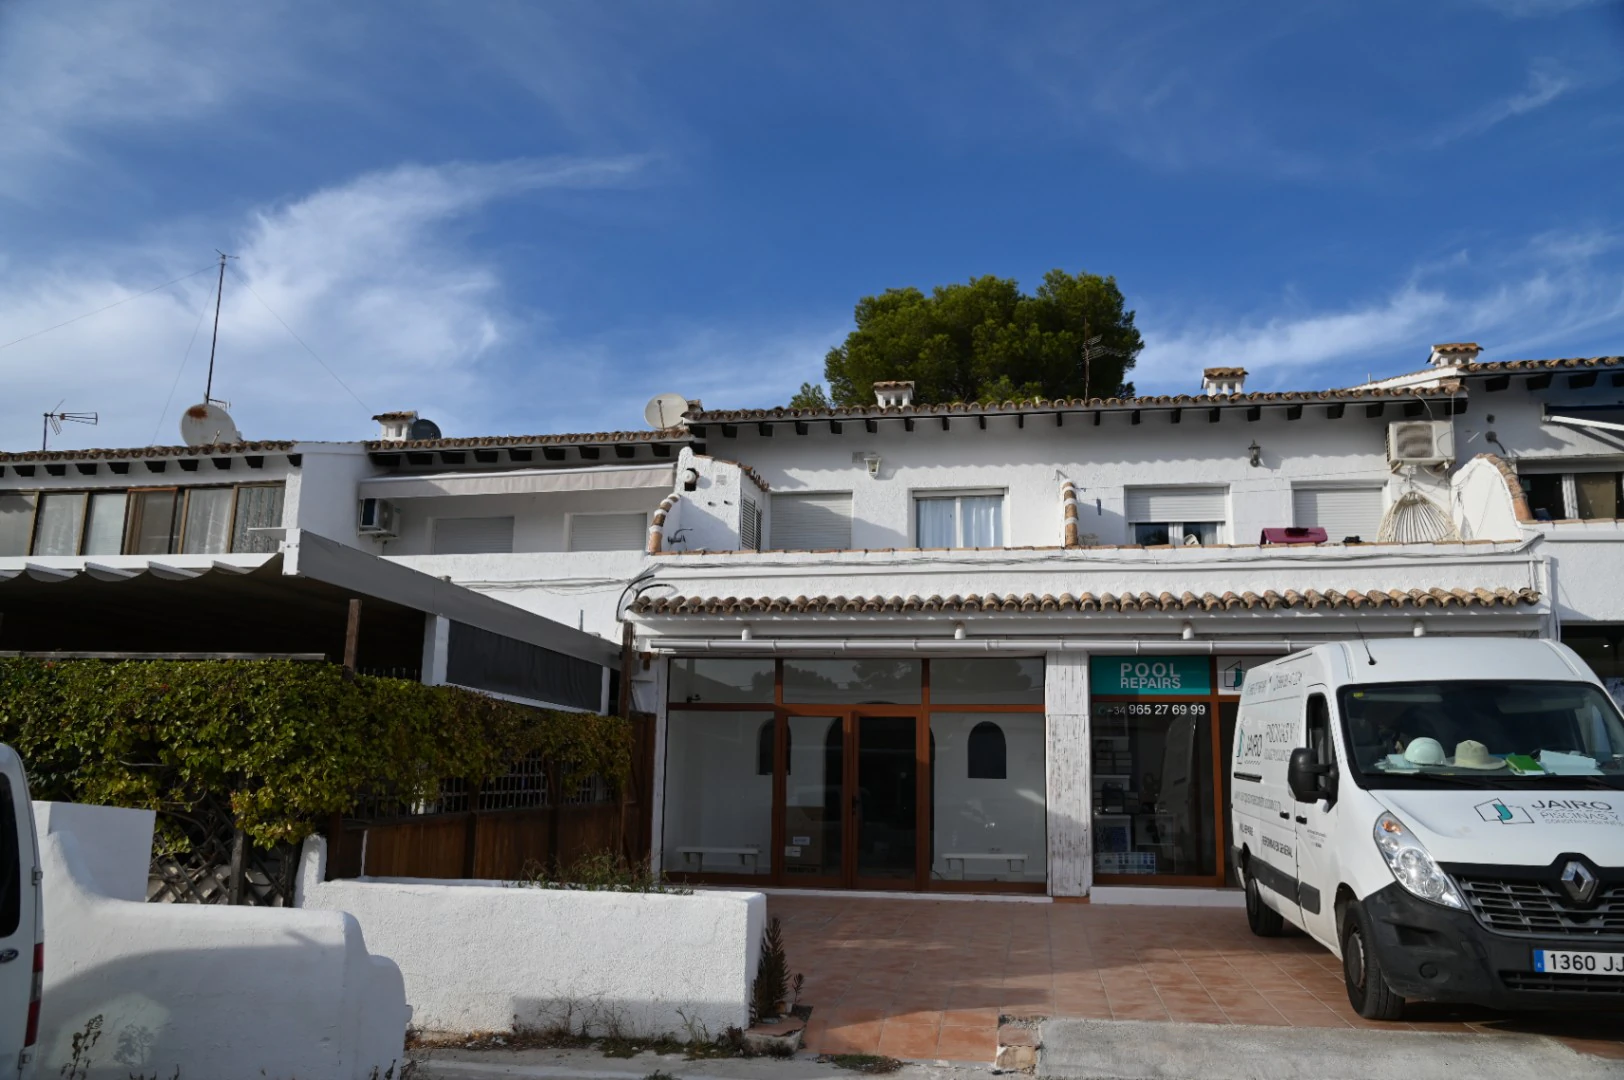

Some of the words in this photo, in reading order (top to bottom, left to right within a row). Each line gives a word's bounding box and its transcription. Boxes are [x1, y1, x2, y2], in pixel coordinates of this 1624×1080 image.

[1120, 663, 1181, 678] POOL
[1120, 677, 1181, 689] REPAIRS
[1128, 704, 1151, 715] 965
[1154, 704, 1168, 715] 27
[1172, 704, 1187, 715] 69
[1190, 704, 1206, 716] 99
[1531, 800, 1613, 811] JAIRO
[1550, 953, 1596, 971] 1360
[1603, 956, 1624, 973] JJ
